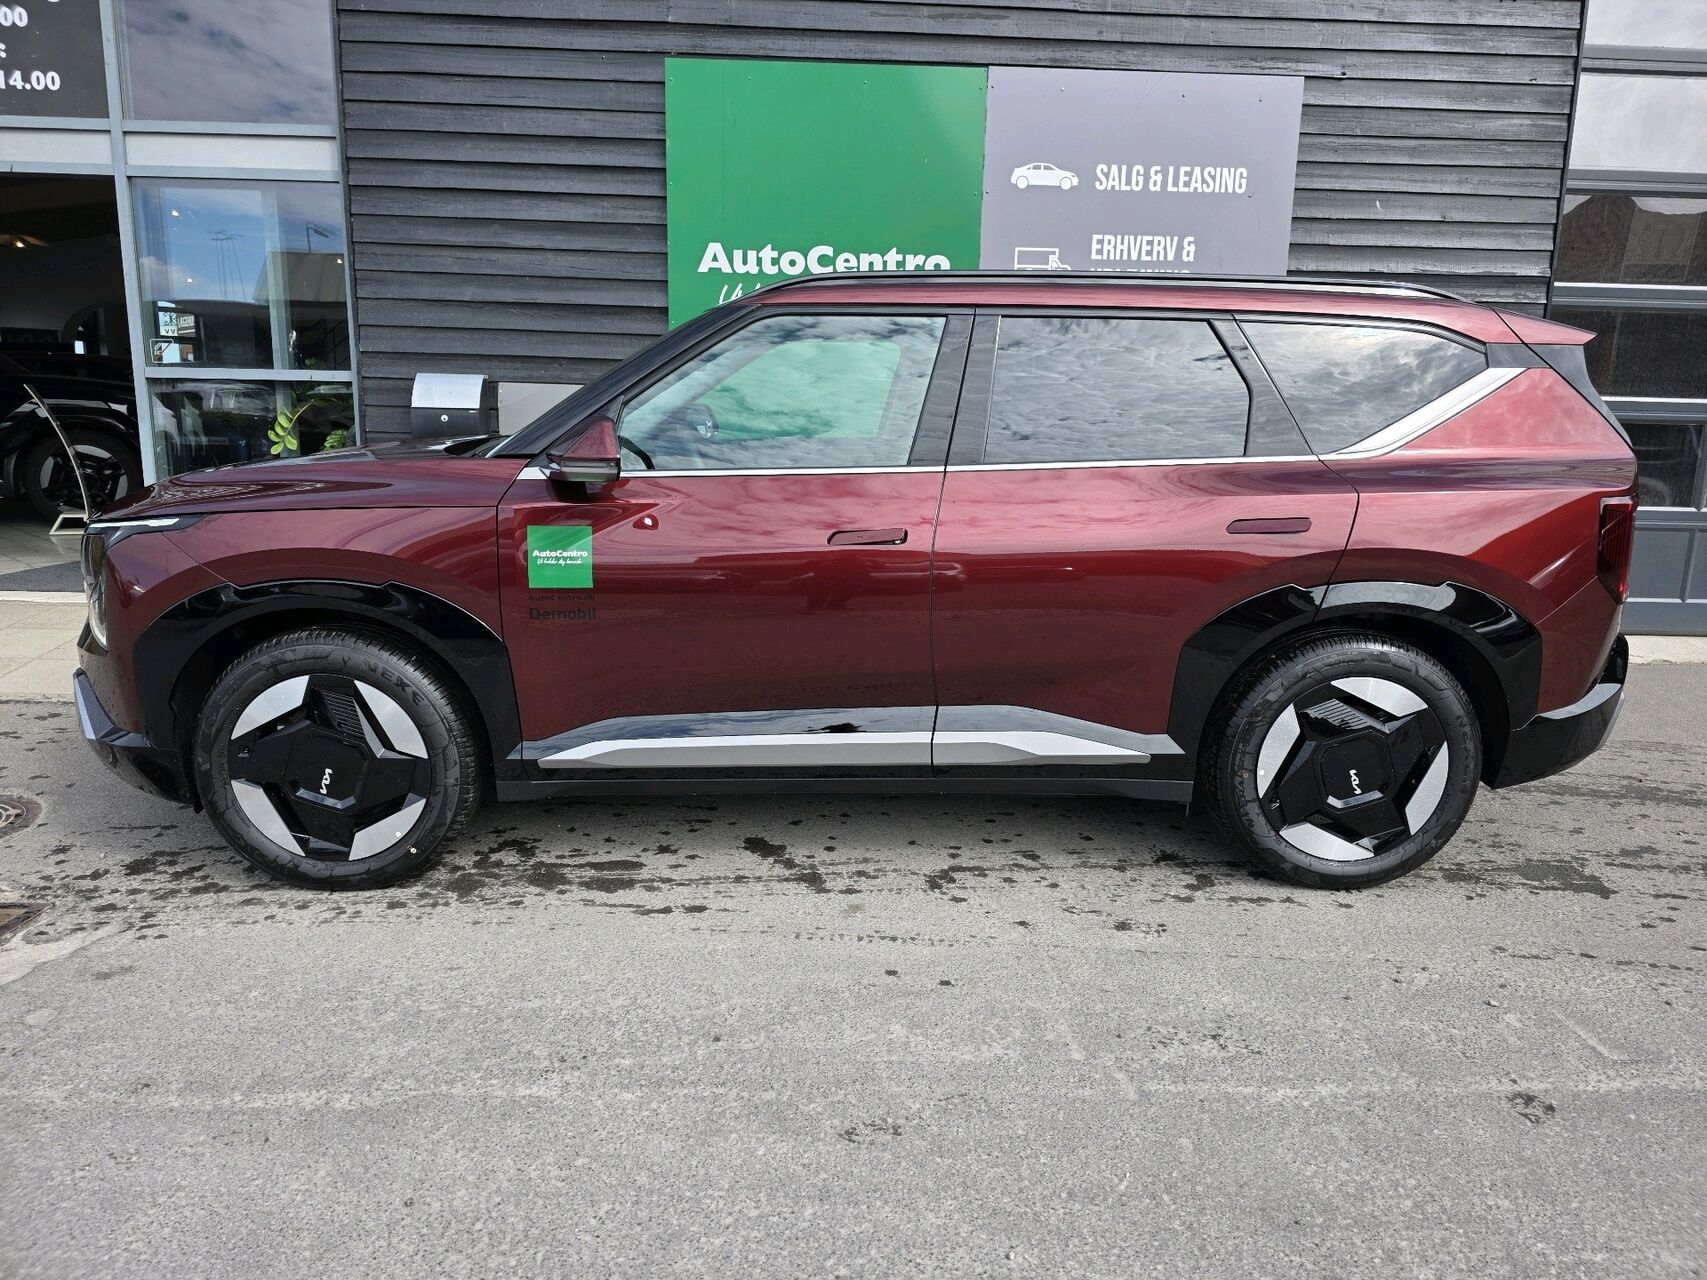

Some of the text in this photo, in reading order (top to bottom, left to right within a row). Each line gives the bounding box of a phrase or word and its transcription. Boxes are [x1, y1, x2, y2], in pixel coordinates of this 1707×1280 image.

[1095, 164, 1248, 193] SALG & LEASING
[697, 242, 951, 275] AutoCentro
[1090, 234, 1195, 262] ERHVERV &
[528, 607, 596, 619] Demobil
